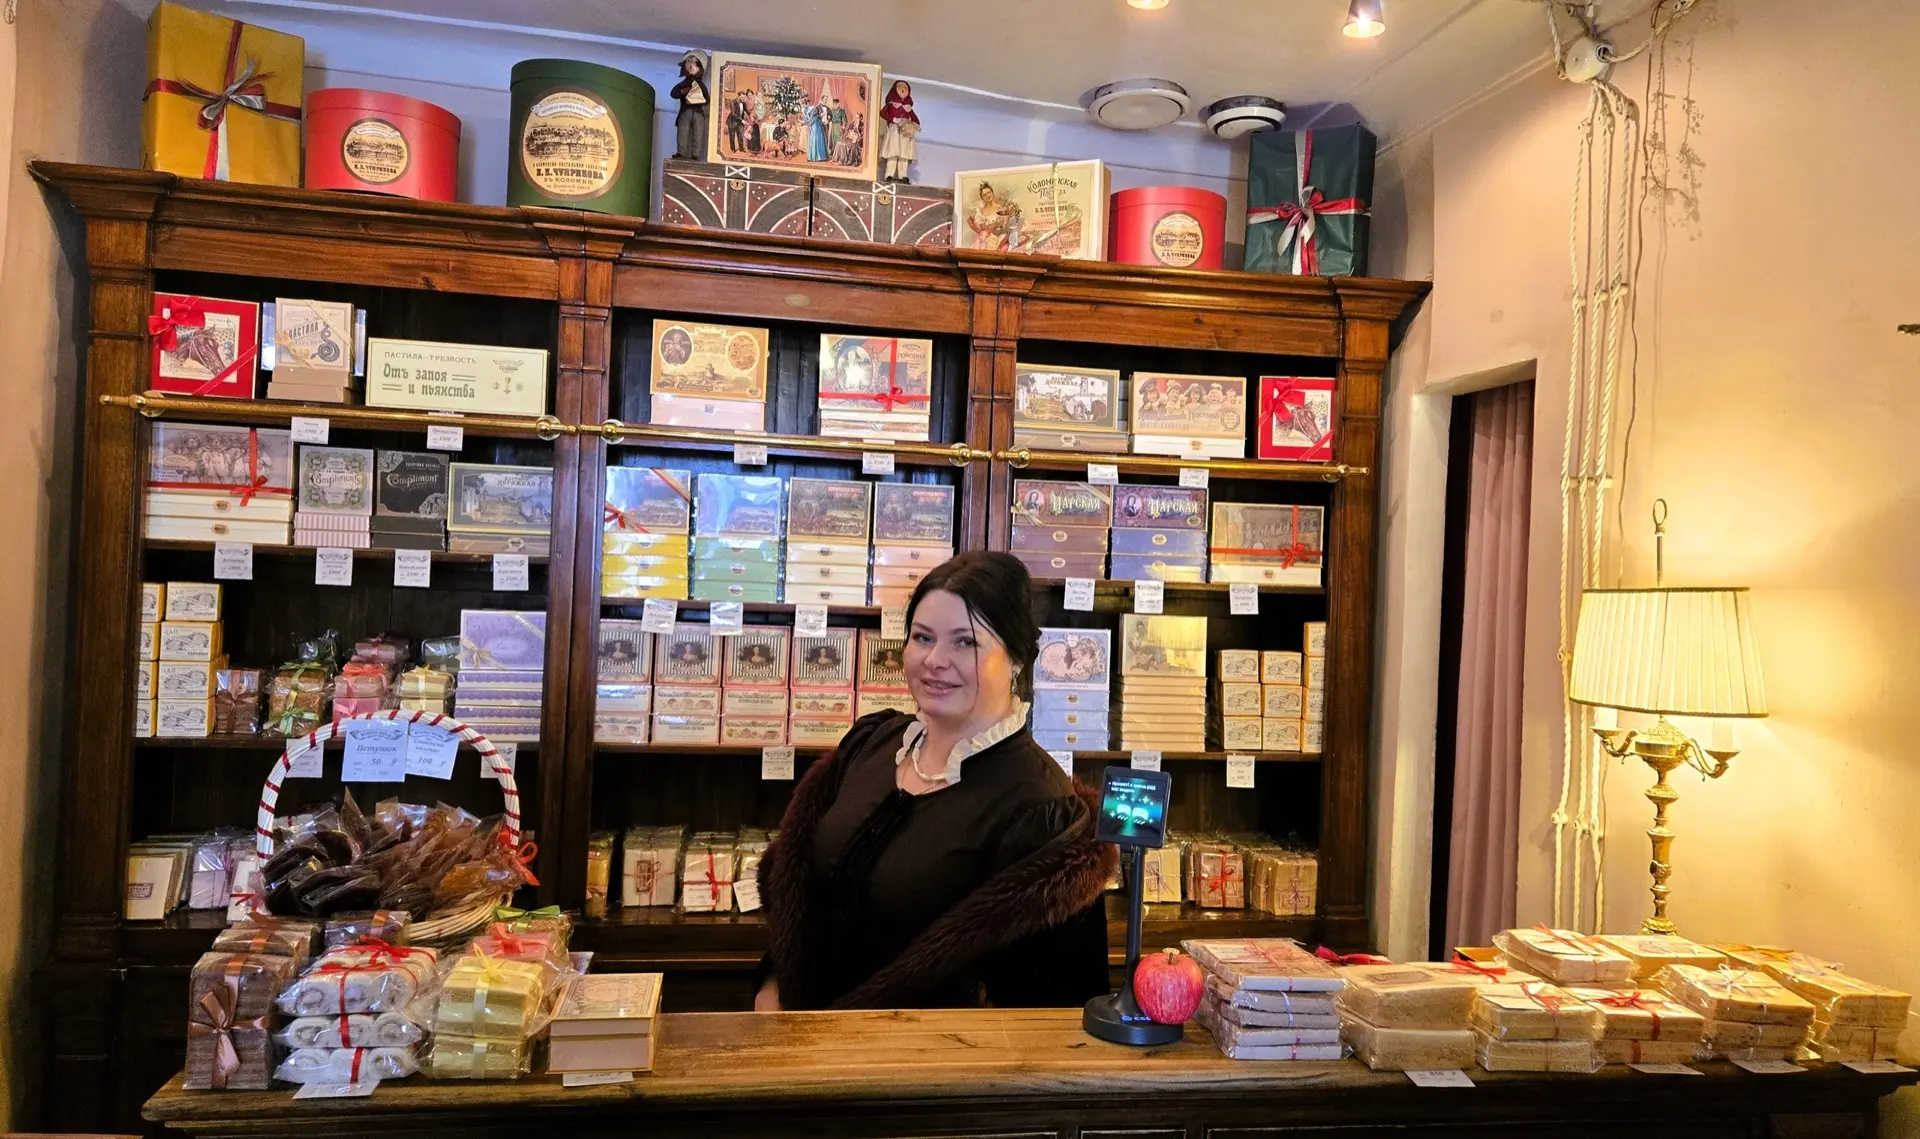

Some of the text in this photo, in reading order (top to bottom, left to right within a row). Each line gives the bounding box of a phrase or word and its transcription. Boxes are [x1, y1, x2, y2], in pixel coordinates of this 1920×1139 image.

[553, 168, 604, 180] ЧУПРИКОВА
[415, 368, 448, 382] запоя
[408, 383, 415, 395] и
[1050, 491, 1100, 516] ЦАРСКАЯ
[1148, 495, 1197, 519] ЦАРСКАЯ
[356, 745, 397, 754] Петушок
